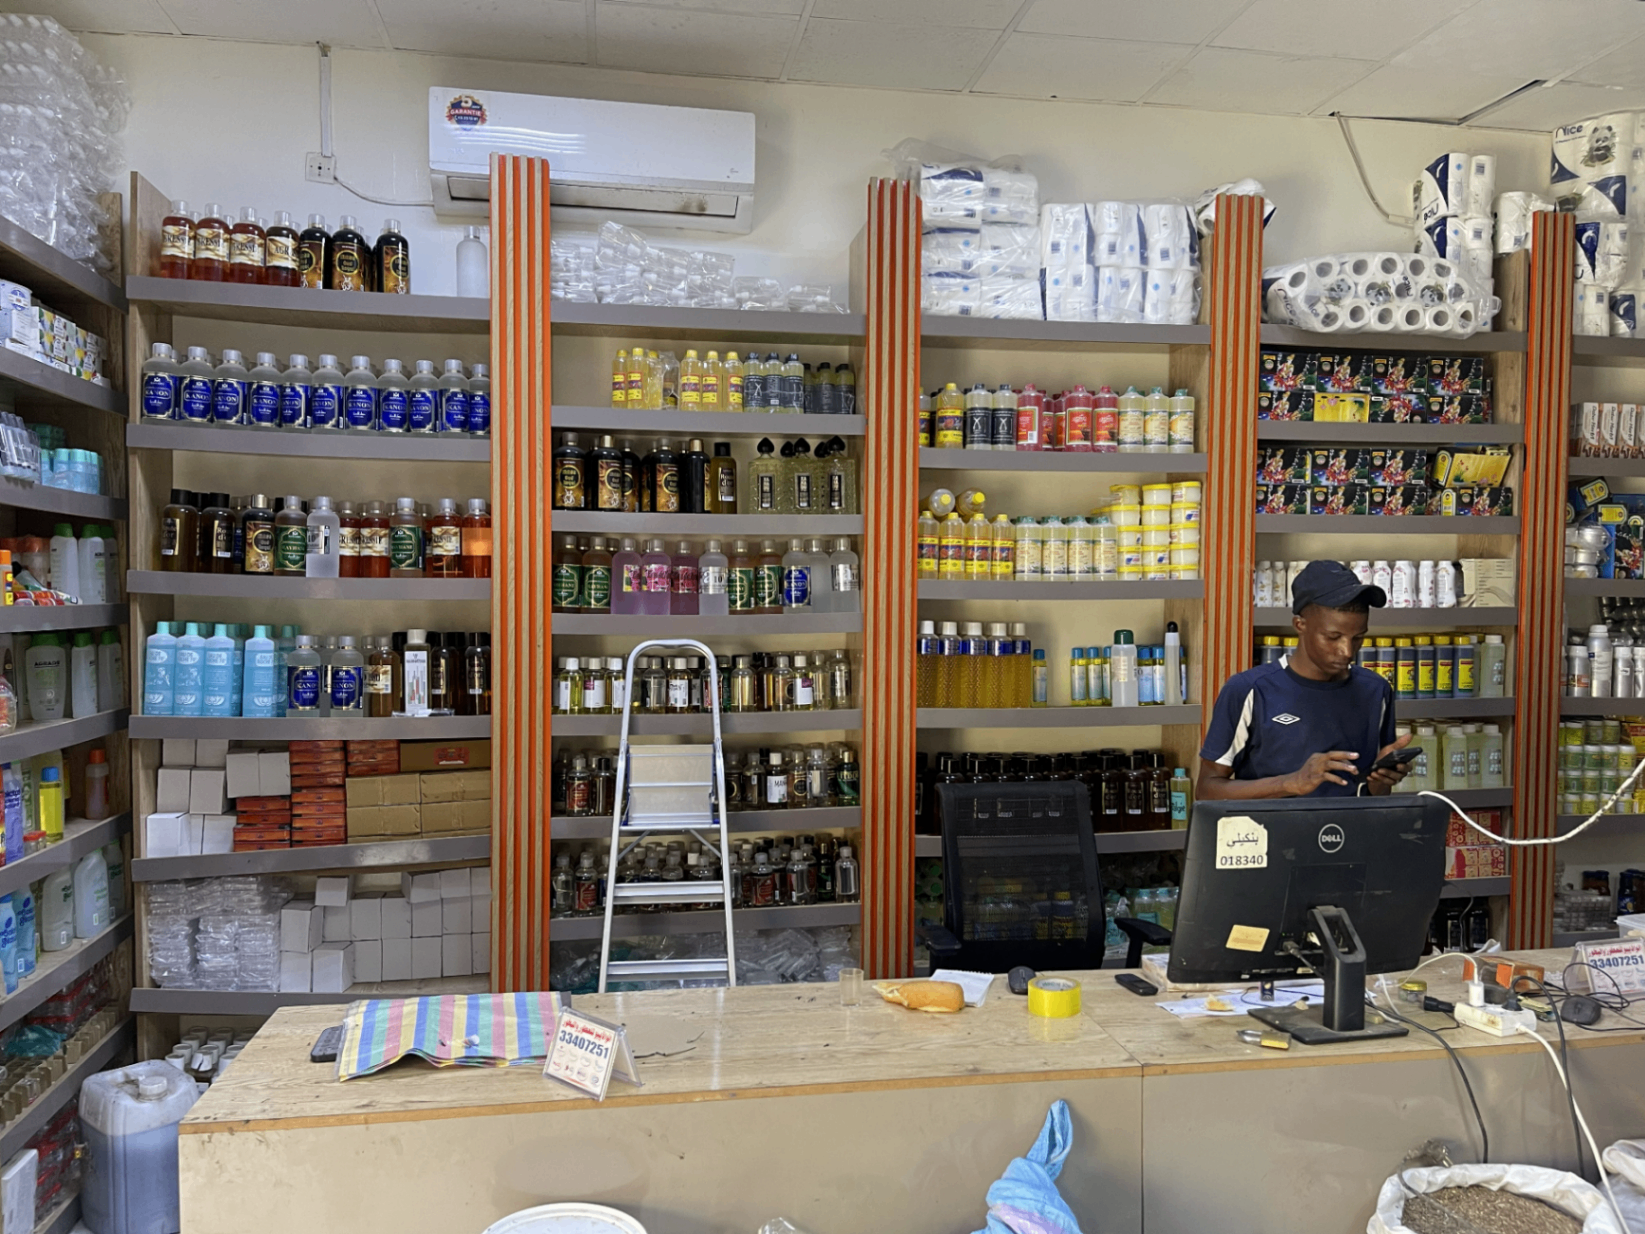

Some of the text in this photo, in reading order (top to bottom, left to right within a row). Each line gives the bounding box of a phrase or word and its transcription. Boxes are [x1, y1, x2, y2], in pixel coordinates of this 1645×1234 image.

[450, 108, 482, 116] GARANTIE
[1227, 833, 1260, 848] بنكيلي
[1321, 834, 1342, 843] DELL
[1220, 854, 1264, 867] 018340
[1589, 954, 1645, 969] 33407251
[559, 1029, 609, 1059] 33407251
